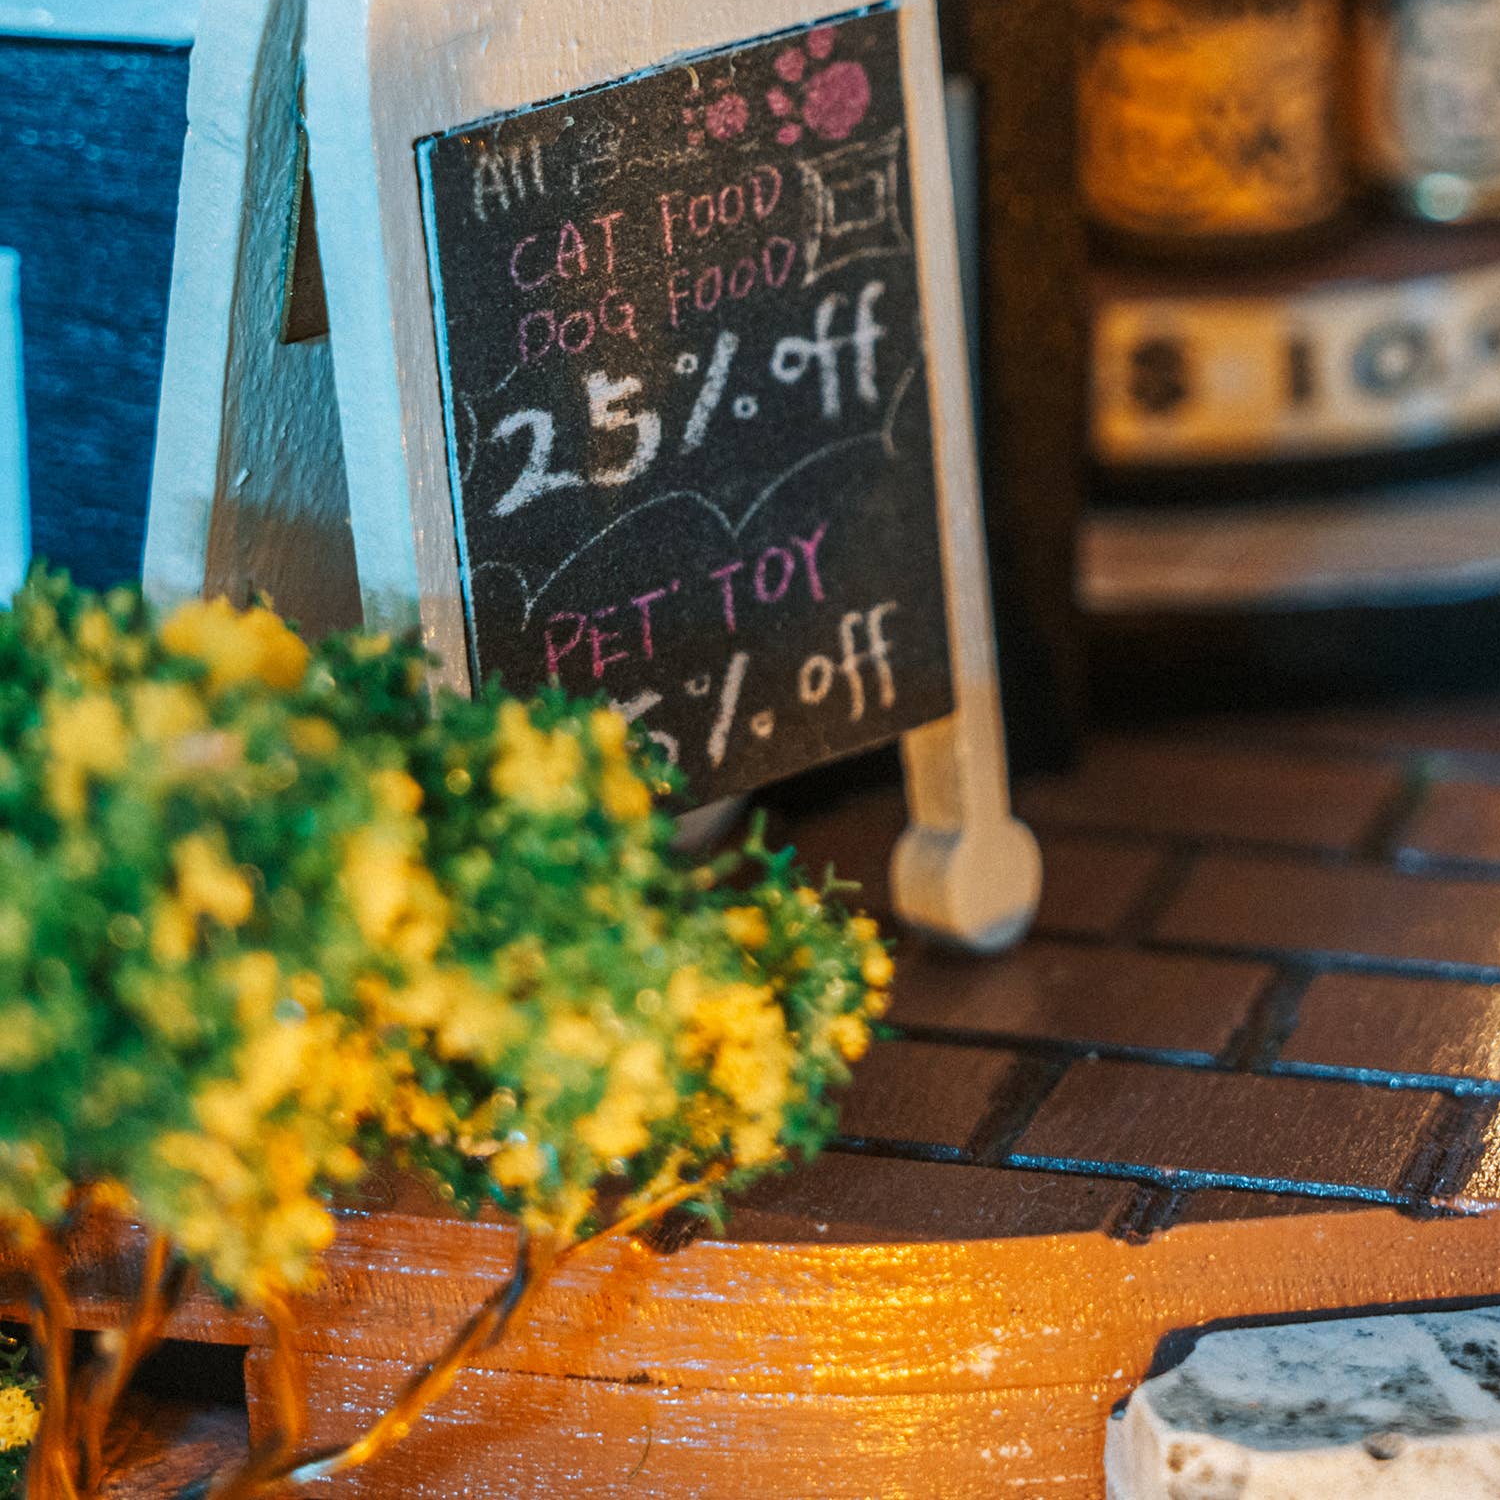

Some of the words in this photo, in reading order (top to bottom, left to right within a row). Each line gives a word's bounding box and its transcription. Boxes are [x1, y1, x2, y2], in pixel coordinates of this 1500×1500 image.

[472, 141, 546, 222] All
[510, 212, 626, 292] CAT
[658, 164, 785, 257] FOOD
[518, 288, 640, 366] DOG
[668, 235, 799, 329] FOOD
[489, 329, 760, 518] 25%
[770, 280, 888, 418] off
[710, 523, 828, 634] TOY
[798, 599, 899, 723] off
